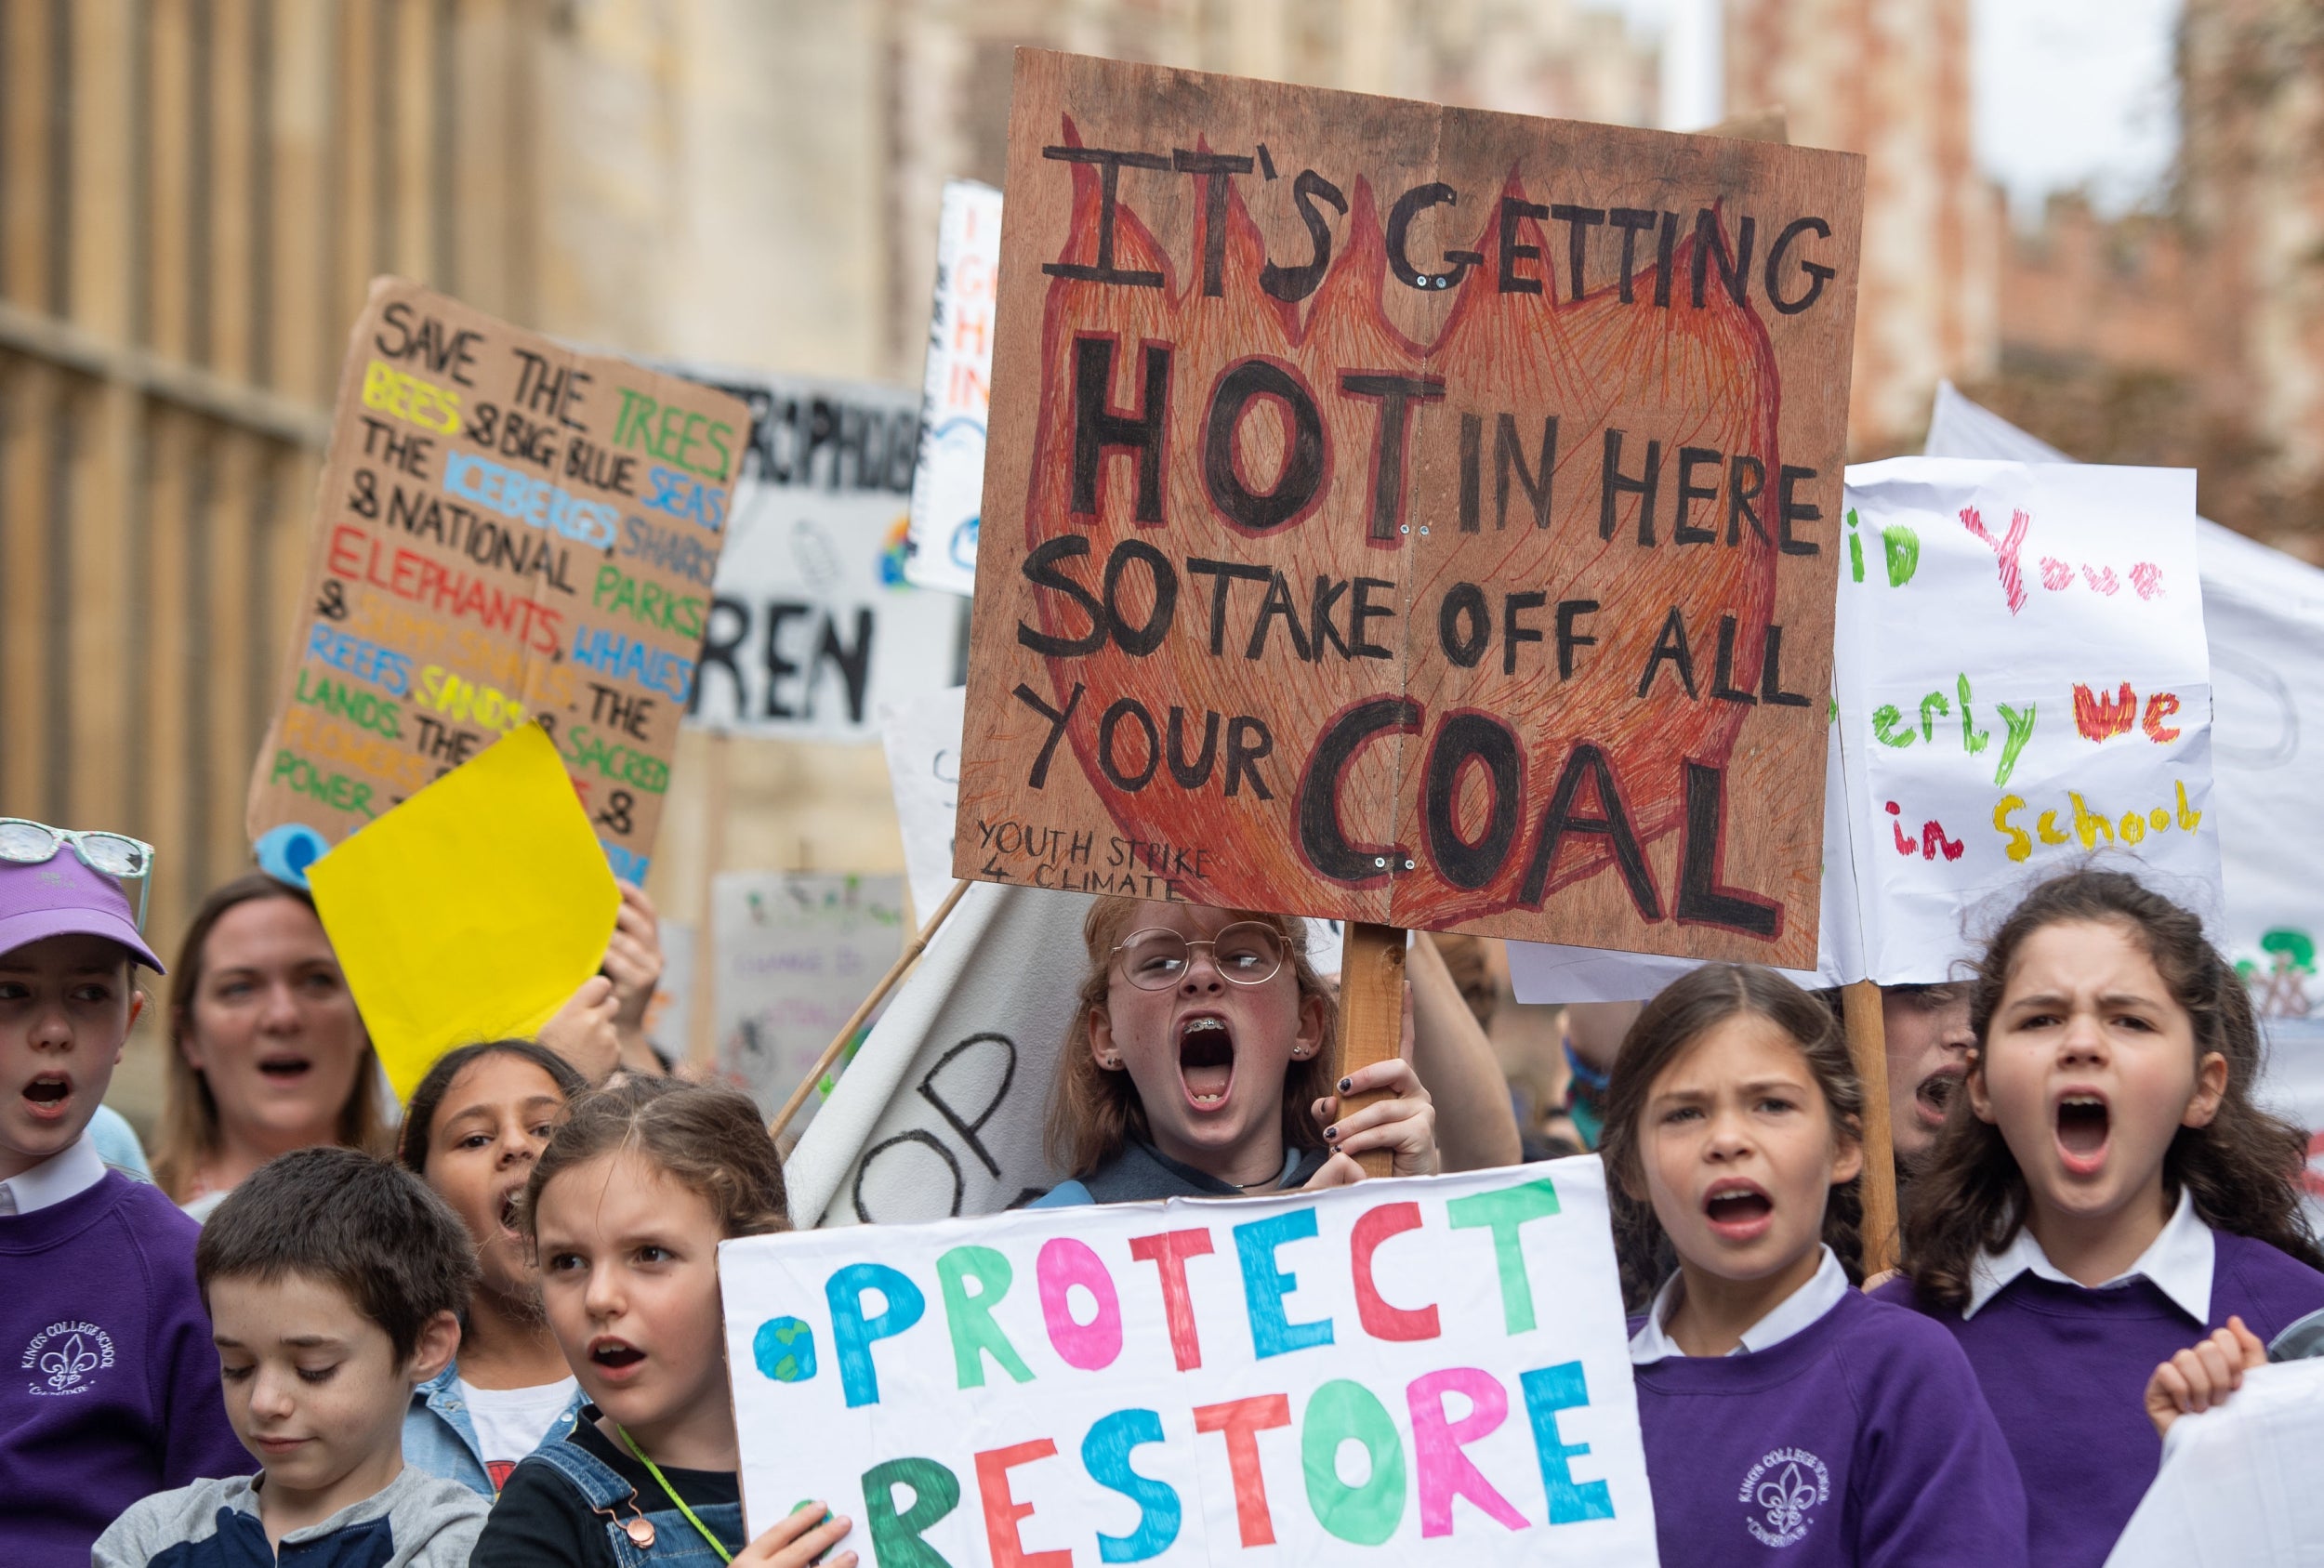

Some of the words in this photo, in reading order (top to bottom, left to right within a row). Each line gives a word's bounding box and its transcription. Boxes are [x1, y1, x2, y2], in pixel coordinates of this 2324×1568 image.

[1042, 143, 1349, 303] IT'S
[1385, 182, 1836, 315] GETTING
[363, 360, 461, 435] BEES
[464, 402, 499, 447] &
[500, 412, 557, 468] BIG
[563, 437, 637, 496] BLUE
[376, 302, 485, 388] SAVE
[512, 347, 593, 432] THE
[361, 415, 434, 480] THE
[1069, 333, 1448, 543] HOT
[1459, 412, 1559, 535] IN
[1599, 428, 1823, 556] HERE
[350, 468, 379, 519] &
[388, 484, 575, 594] NATIONAL
[592, 564, 707, 639] PARKS
[316, 578, 348, 621] &
[588, 682, 655, 741] THE
[572, 625, 696, 704] WHALES
[1018, 534, 1178, 657] SO
[1186, 557, 1395, 663] TAKE
[1440, 582, 1600, 680] OFF
[1637, 605, 1813, 707] ALL
[270, 749, 376, 819] POWER
[416, 714, 480, 765] THE
[594, 790, 634, 835] &
[561, 725, 671, 795] SACRED
[1829, 672, 2036, 788] erly
[978, 820, 1092, 864] YOUTH
[1107, 837, 1210, 878] STRIKE
[1012, 681, 1274, 800] YOUR
[1296, 695, 1781, 939] COAL
[1885, 800, 1964, 862] in
[1993, 780, 2201, 863] School
[981, 853, 1014, 882] 4
[1036, 863, 1185, 902] CLIMATE
[818, 1033, 1016, 1225] OP
[46, 1321, 100, 1336] COLLEGE
[95, 1331, 115, 1368] SCHOOL
[825, 1178, 1561, 1408] PROTECT
[861, 1360, 1616, 1568] RESTORE
